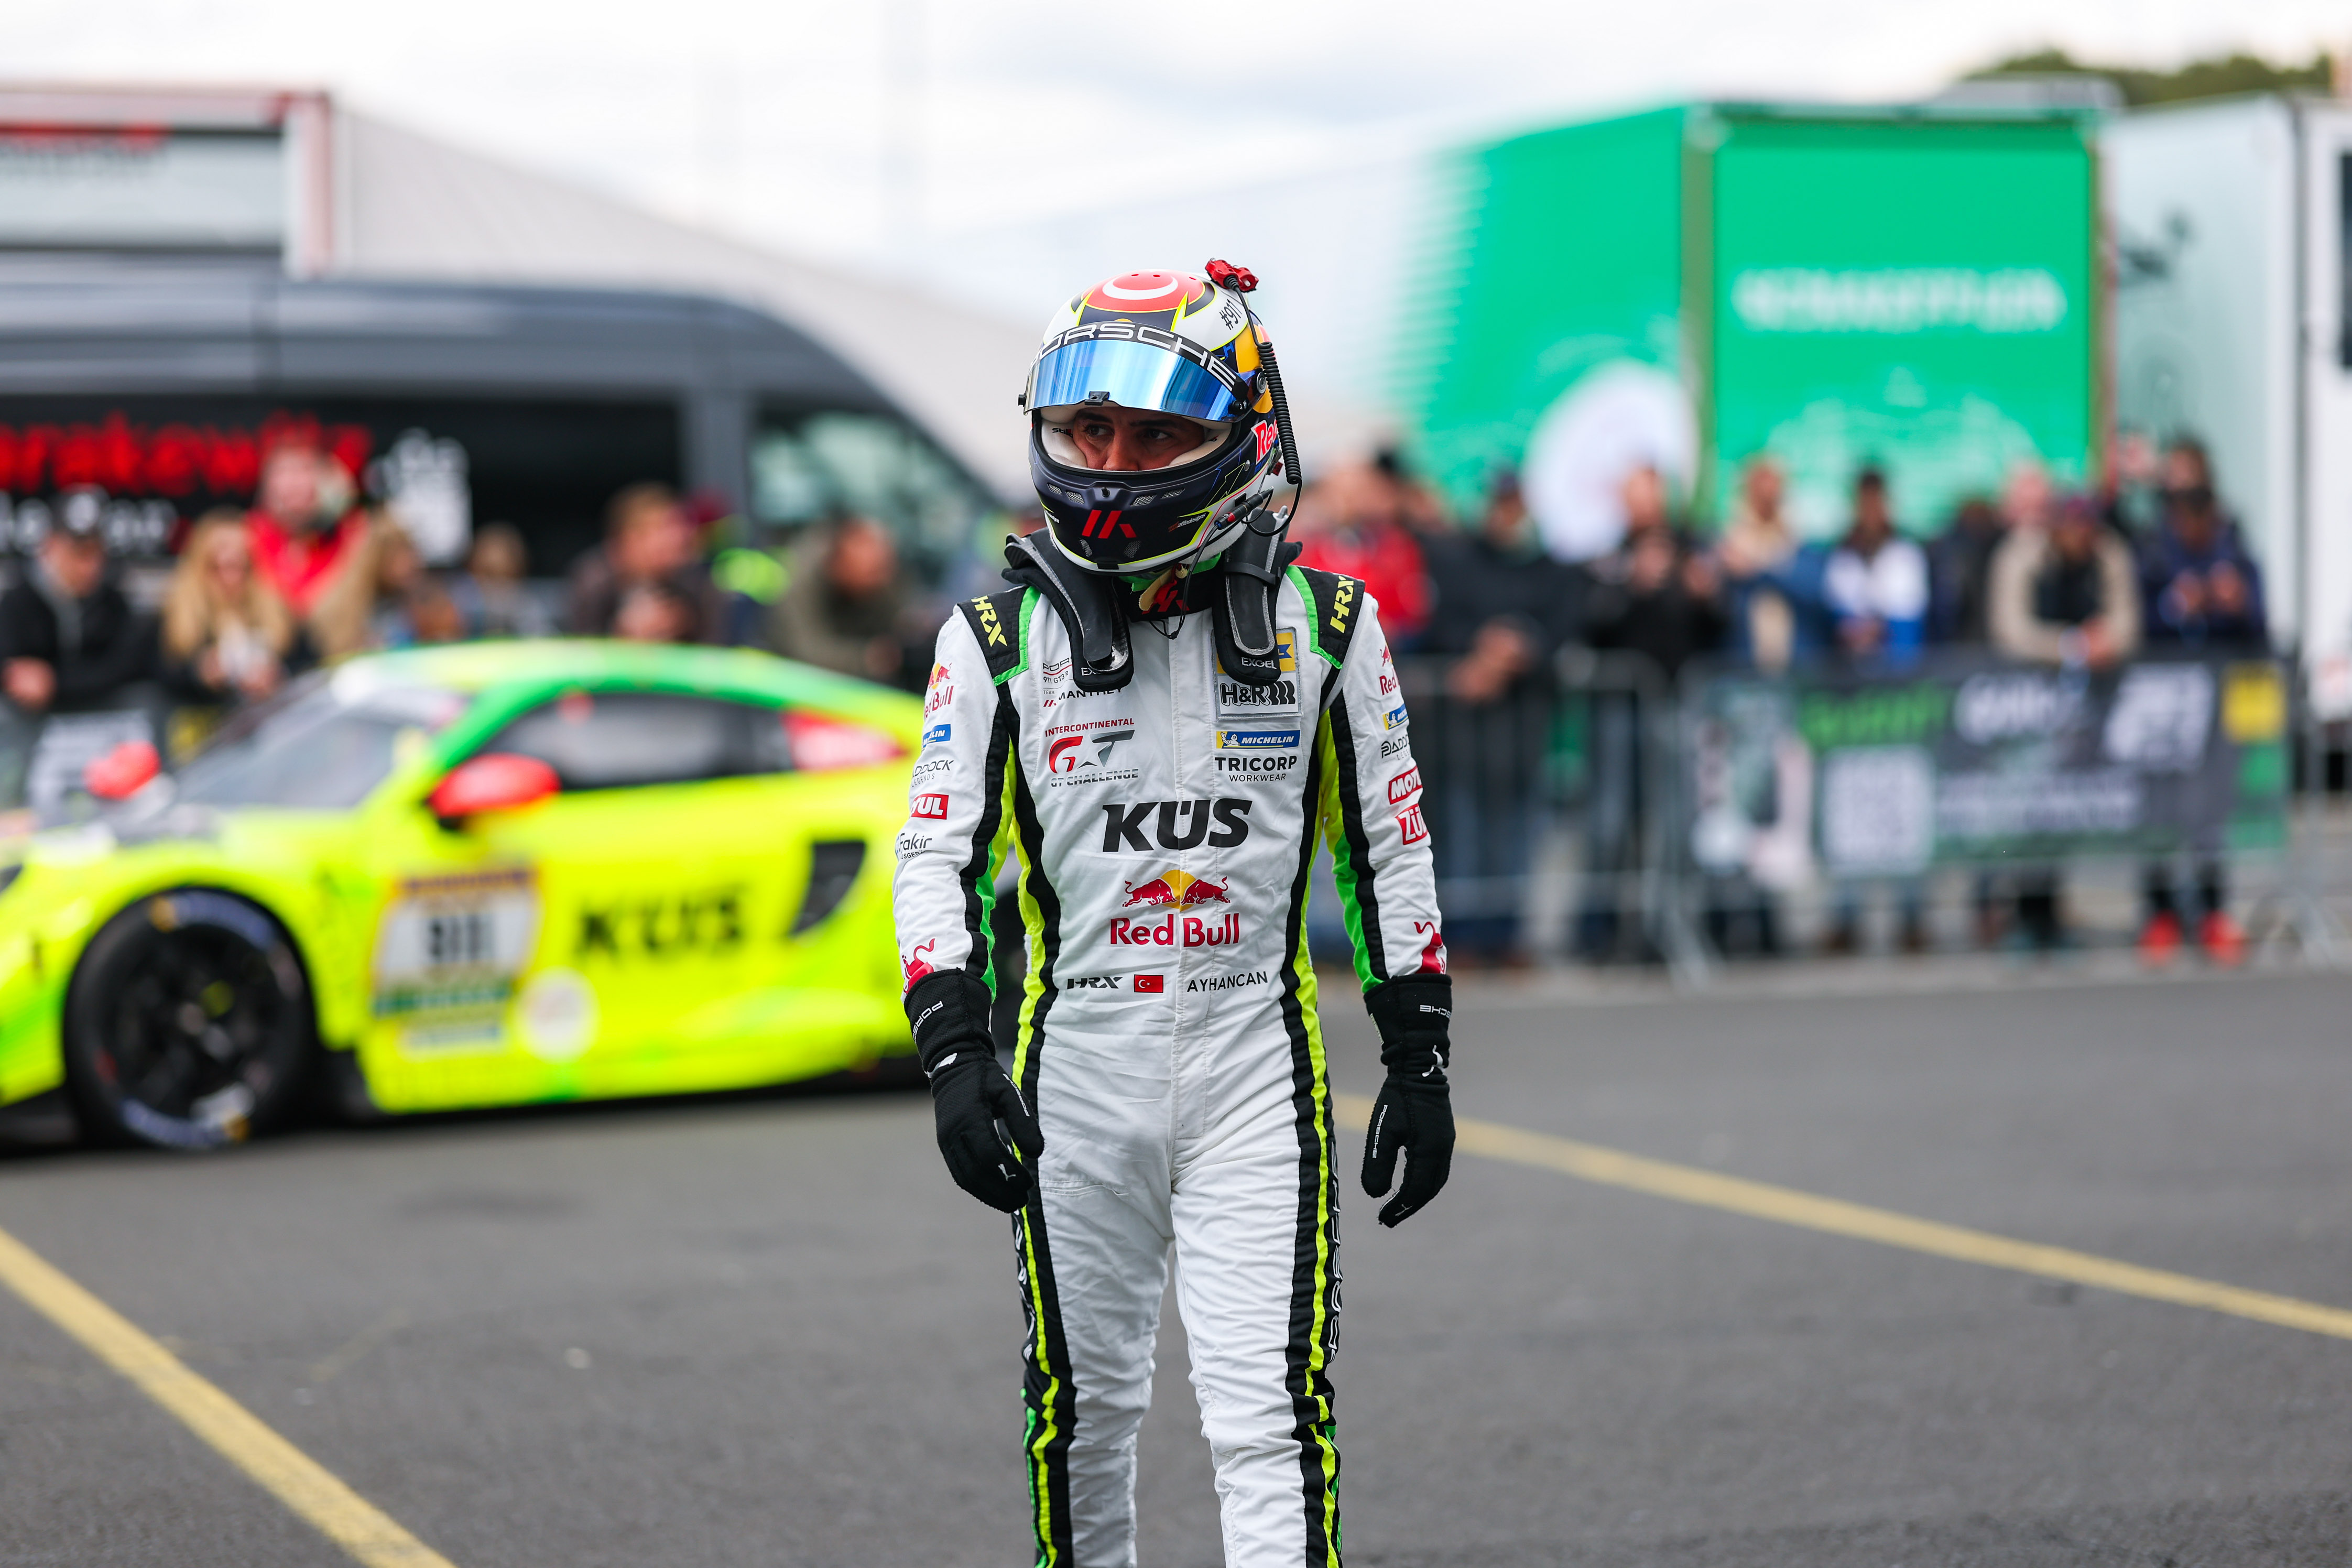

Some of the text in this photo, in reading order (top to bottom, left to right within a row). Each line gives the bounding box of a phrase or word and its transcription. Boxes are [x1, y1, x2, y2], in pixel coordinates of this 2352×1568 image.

[1219, 298, 1243, 331] #911
[1330, 575, 1354, 633] HRX
[971, 595, 1008, 647] HRX
[1242, 657, 1277, 669] EXGEL
[1053, 674, 1064, 683] GT3
[932, 685, 954, 711] Bull
[1045, 718, 1135, 737] INTERCONTINENTAL
[913, 760, 954, 777] DDOCK
[1215, 755, 1297, 771] TRICORP
[1051, 769, 1139, 787] GT CHALLENGE
[1229, 774, 1286, 782] WORKWEAR
[1102, 799, 1253, 852] KÜS
[1110, 912, 1239, 947] Red Bull
[1067, 971, 1268, 992] HRX AYHANCAN
[1420, 1005, 1451, 1018] SCHE
[1372, 1105, 1388, 1158] PORSCHE
